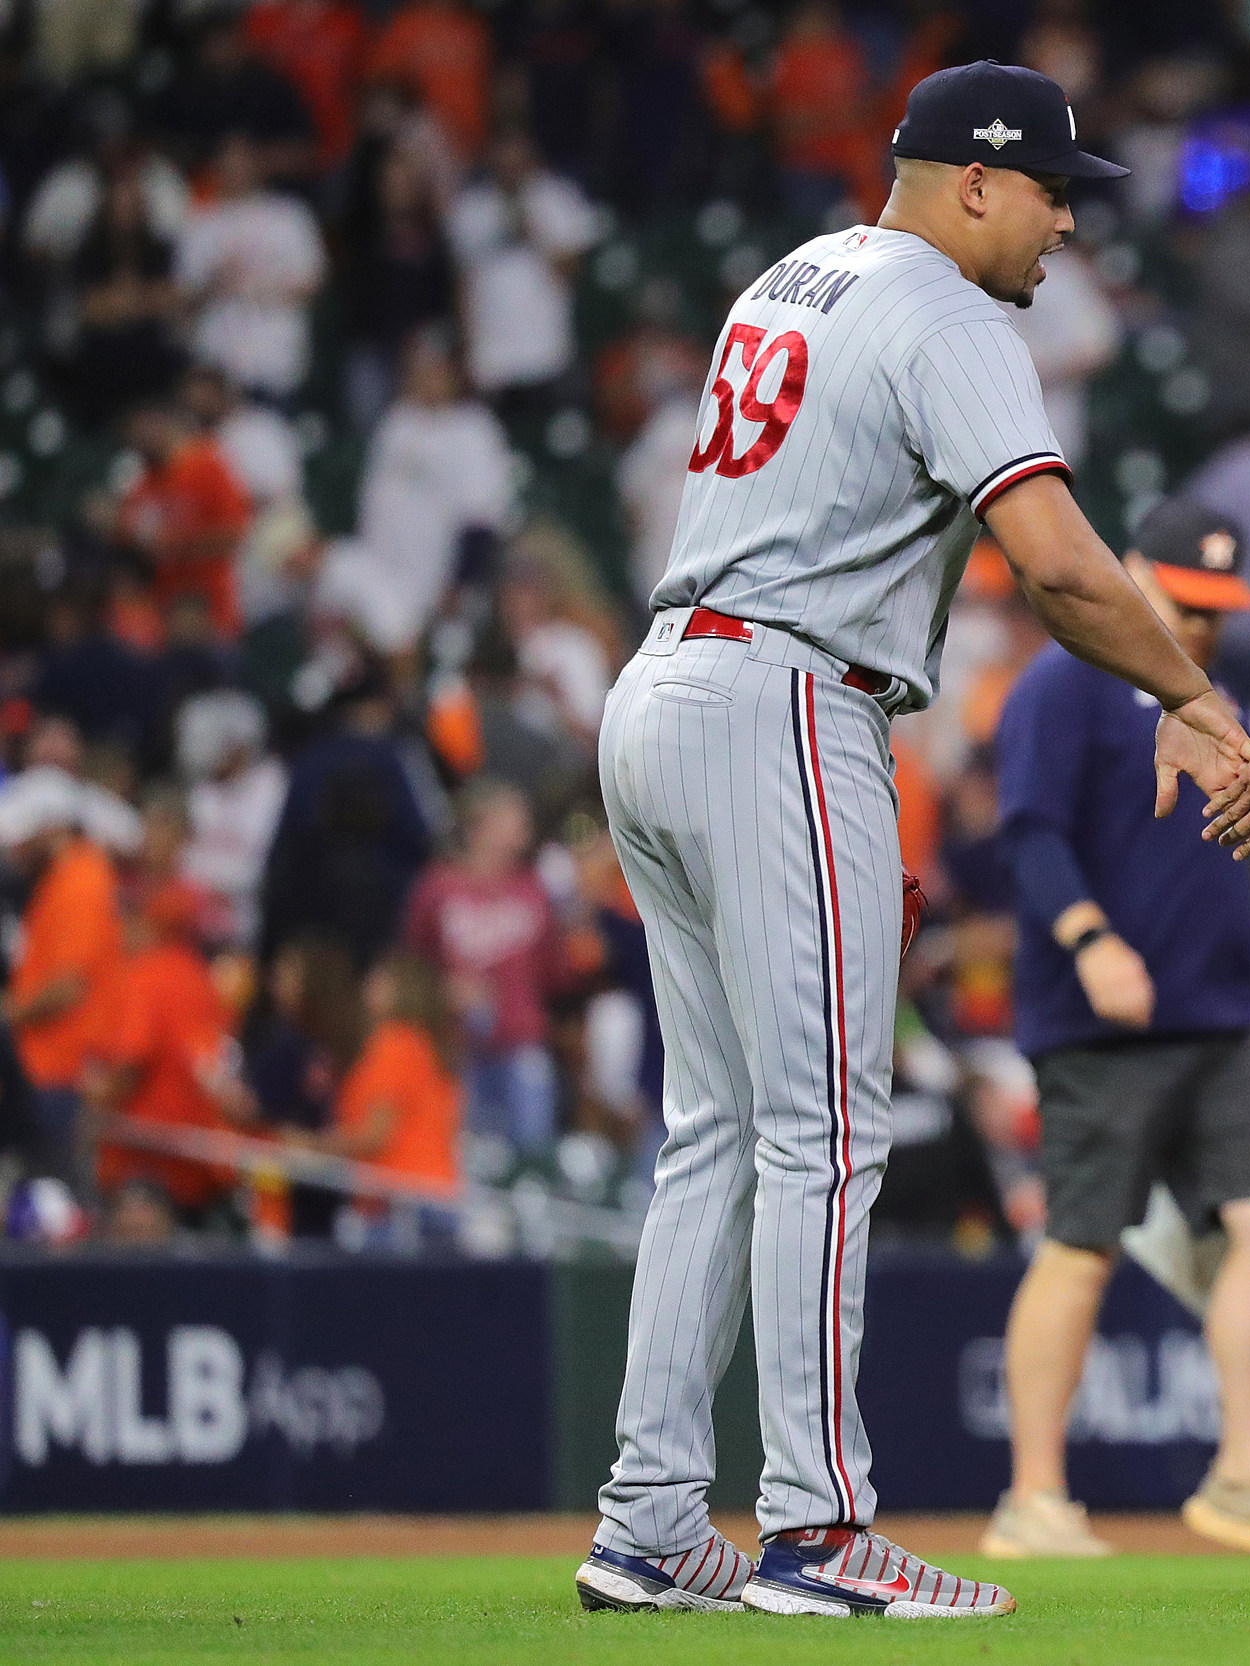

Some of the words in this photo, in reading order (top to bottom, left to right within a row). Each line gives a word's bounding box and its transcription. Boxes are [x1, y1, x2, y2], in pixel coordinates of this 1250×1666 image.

[974, 129, 1021, 140] POSTSEASON
[751, 260, 859, 315] DURAN
[688, 322, 809, 478] 59
[14, 1325, 249, 1466] MLB
[249, 1349, 386, 1460] App
